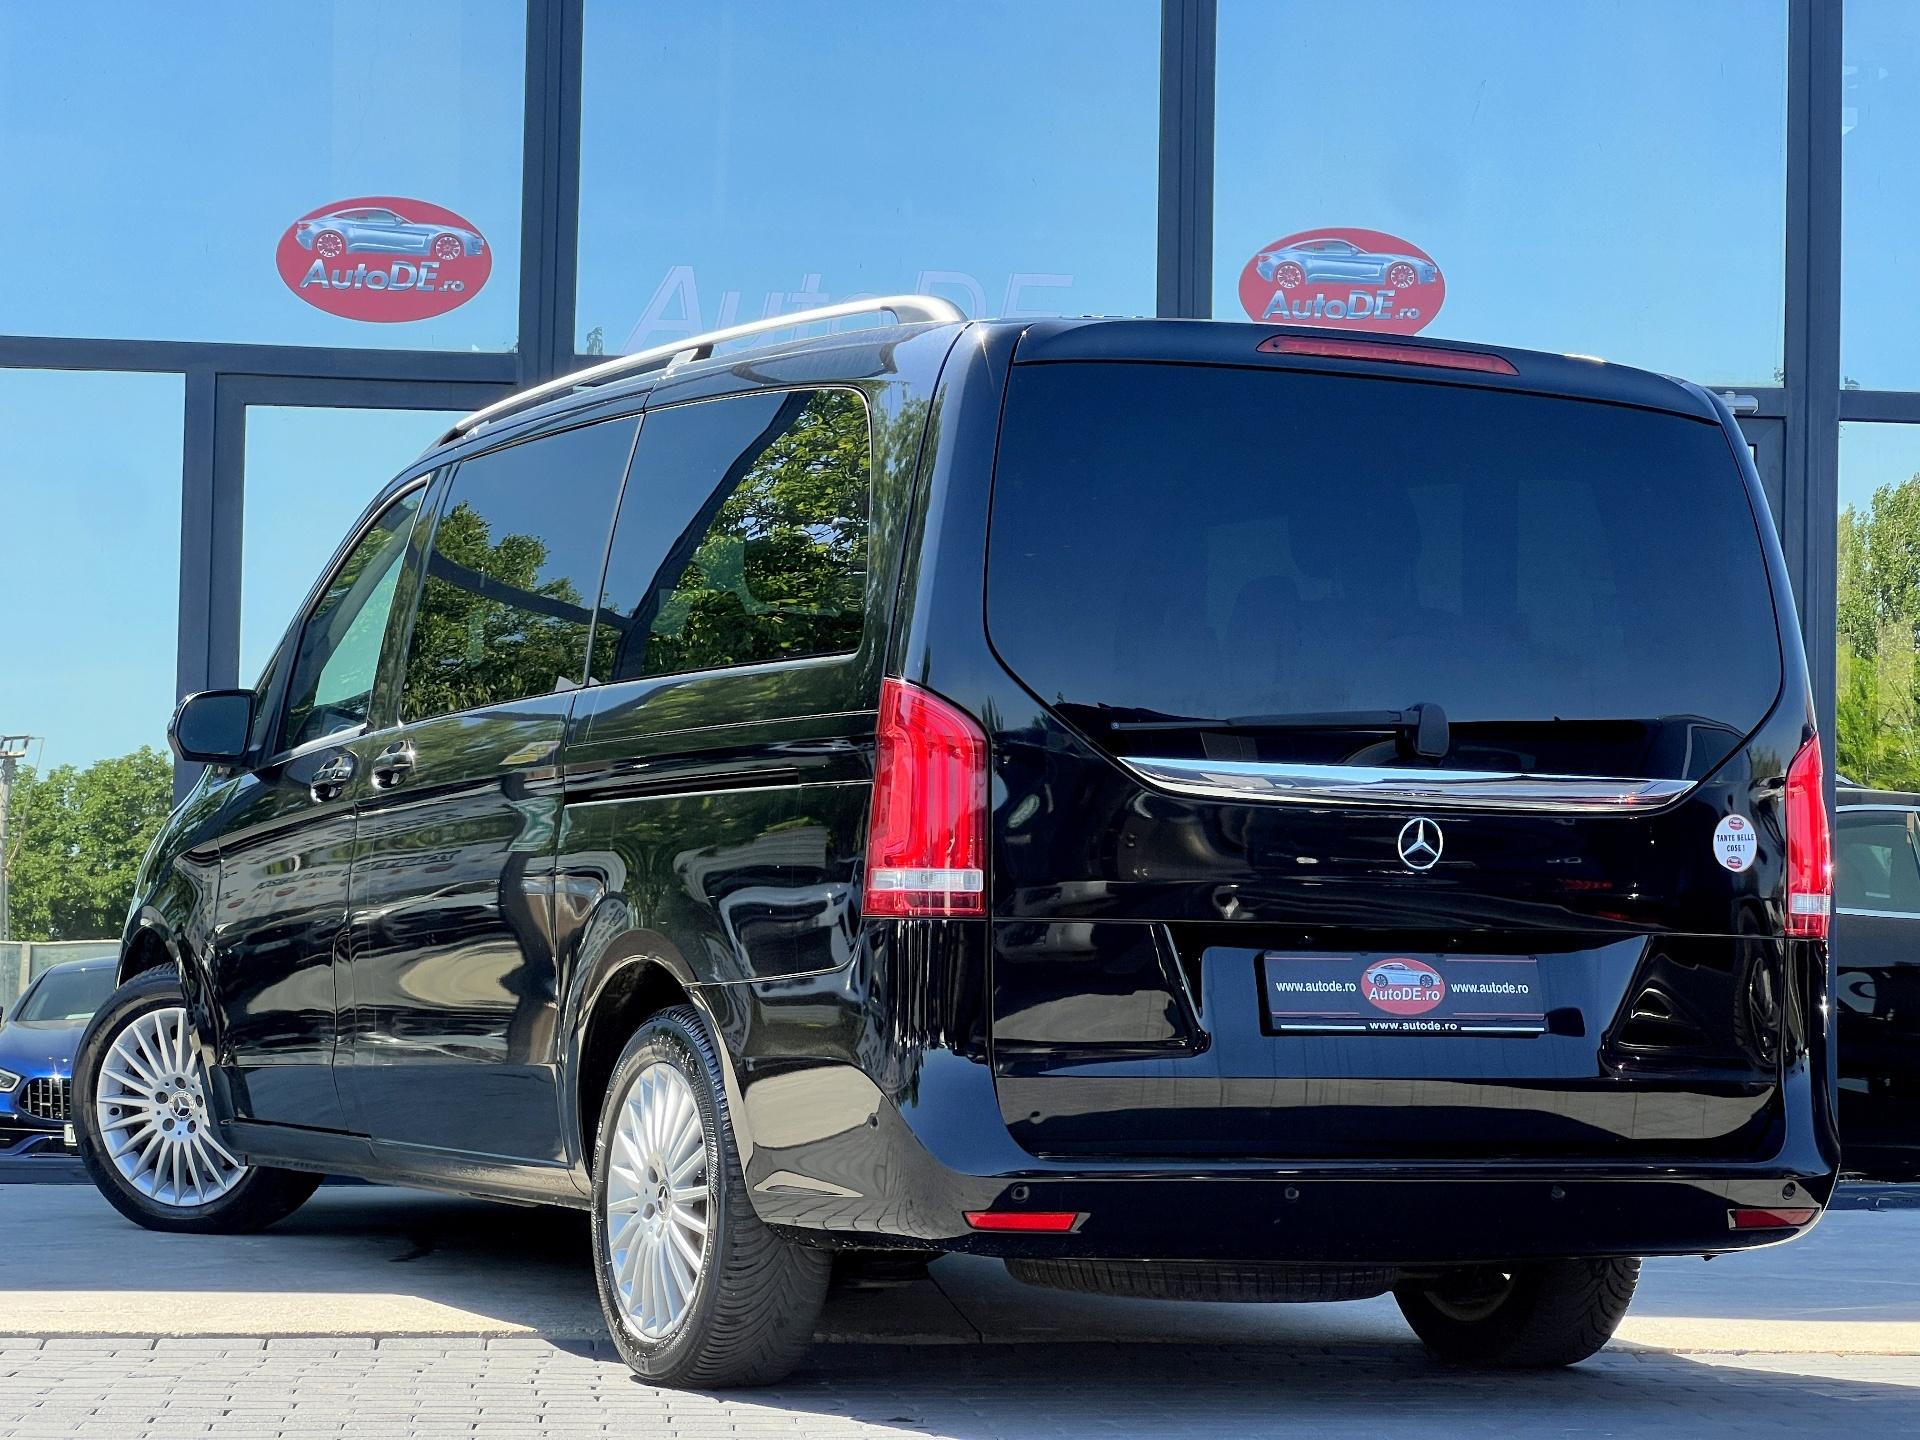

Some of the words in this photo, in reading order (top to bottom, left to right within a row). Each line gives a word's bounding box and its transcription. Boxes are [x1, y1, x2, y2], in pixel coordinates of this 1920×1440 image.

[1716, 834, 1735, 842] TANTE
[1737, 833, 1755, 841] BELLE
[1275, 980, 1357, 992] www.autode.ro
[1450, 981, 1529, 994] www.autode.ro
[1368, 987, 1441, 1001] AutoDE.ro
[1368, 1020, 1458, 1031] www.autode.ro
